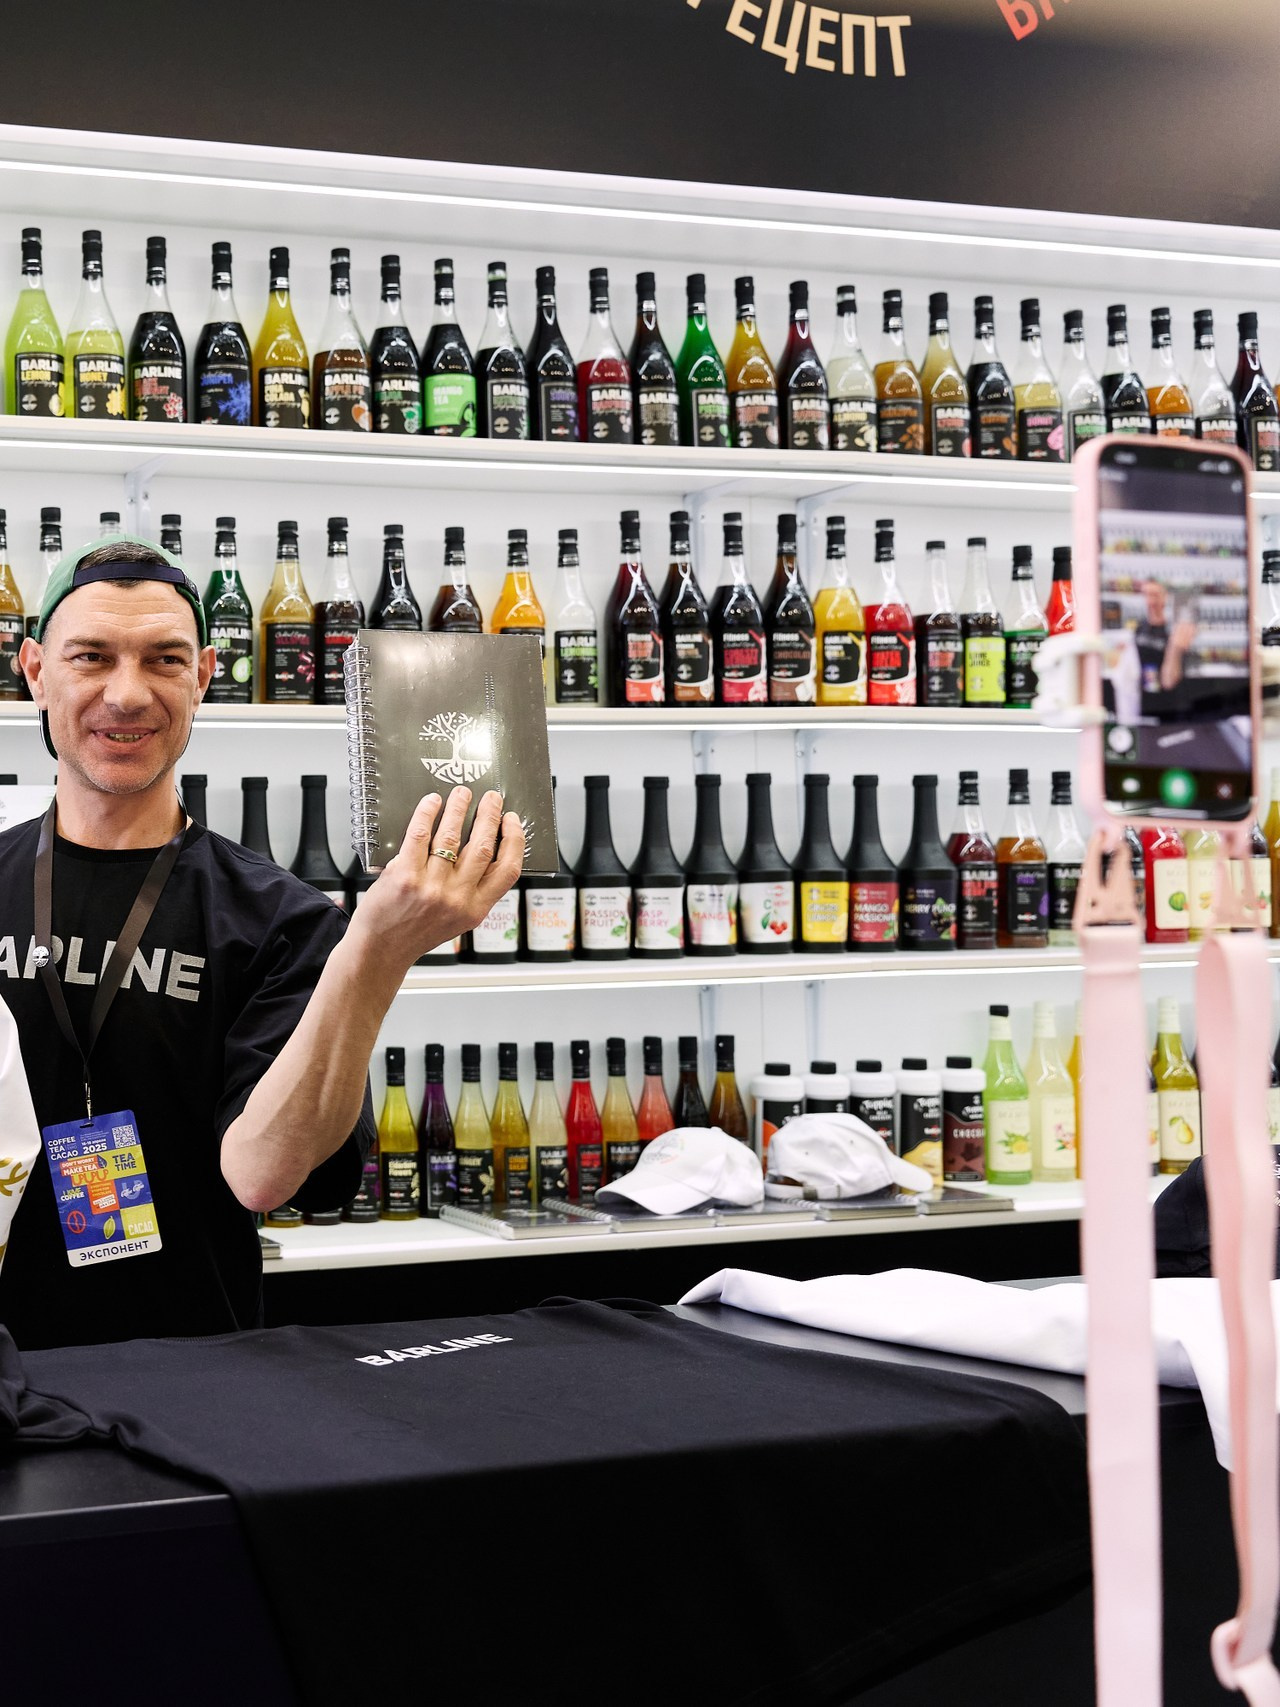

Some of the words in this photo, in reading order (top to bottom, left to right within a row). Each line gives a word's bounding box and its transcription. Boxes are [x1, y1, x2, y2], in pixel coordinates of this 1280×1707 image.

[686, 0, 912, 78] ЕЦЕПТ
[530, 908, 559, 919] BUCK
[853, 902, 890, 913] MANGO
[486, 908, 517, 921] ASSION
[584, 908, 626, 921] PASSION
[530, 919, 568, 930] THORN
[584, 920, 615, 932] FRUIT
[47, 1135, 77, 1147] COFFEE
[49, 1146, 66, 1154] TEA
[82, 1142, 108, 1155] 2025
[50, 1149, 79, 1161] CACAO
[112, 1152, 135, 1164] TEA
[63, 1166, 84, 1176] MAKE
[83, 1164, 98, 1172] TEA
[114, 1161, 137, 1172] TIME
[128, 1220, 155, 1236] CACAO
[79, 1240, 150, 1261] ЭКСПОНЕНТ
[354, 1332, 514, 1367] BARLINE
